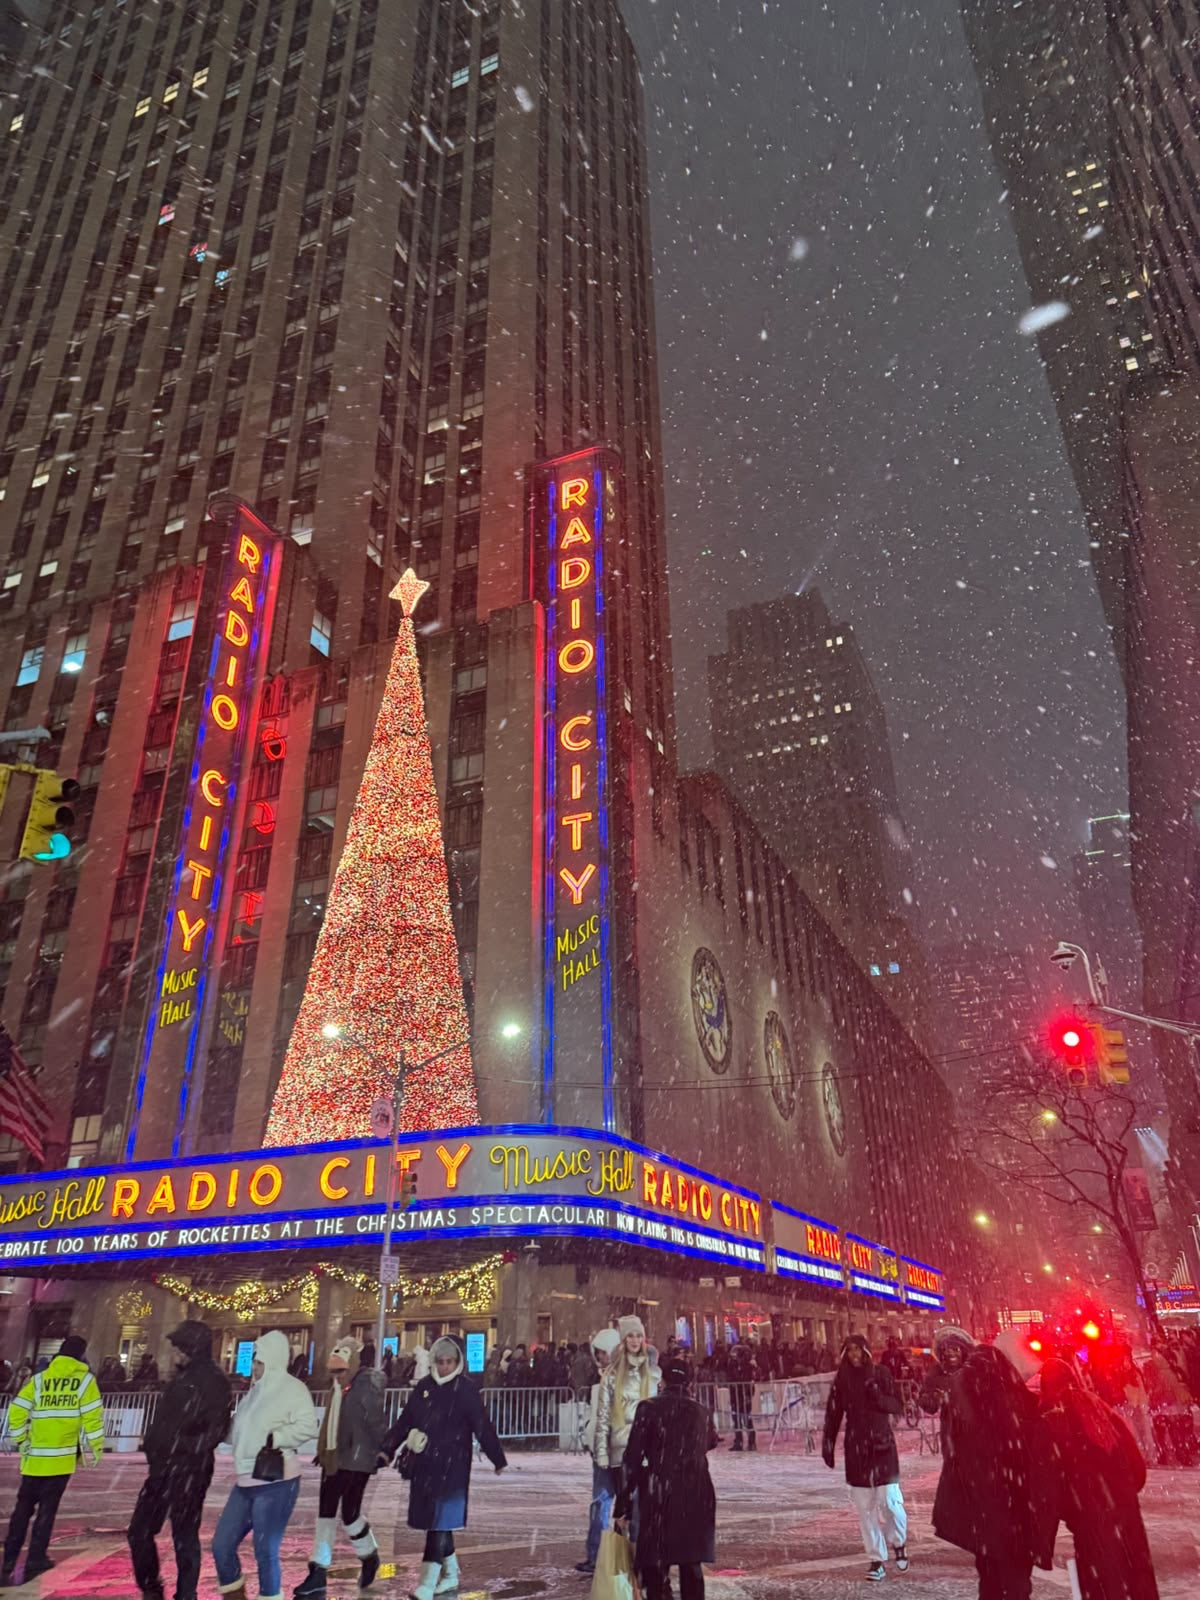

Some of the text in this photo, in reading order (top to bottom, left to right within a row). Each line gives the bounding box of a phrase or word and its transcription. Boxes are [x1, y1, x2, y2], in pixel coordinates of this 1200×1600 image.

[558, 478, 594, 674] RADIO
[211, 534, 260, 731] RADIO
[559, 715, 597, 905] CITY
[177, 769, 227, 952] CITY
[556, 914, 600, 962] MUSIC
[160, 967, 198, 998] MUSIC
[561, 948, 601, 991] HALL
[159, 999, 191, 1028] HALL
[0, 1143, 634, 1229] usic Hall RADIO CITY Music Hall
[643, 1162, 761, 1235] RADIO CITY
[56, 1237, 84, 1253] 100
[94, 1233, 138, 1251] YEARS
[147, 1230, 169, 1247] OF
[177, 1223, 271, 1244] ROCKETTES
[280, 1219, 304, 1238] AT
[314, 1217, 345, 1236] THE
[356, 1208, 457, 1233] CHRISTMAS
[616, 1211, 635, 1232] NOW
[637, 1216, 668, 1240] PLAYING
[670, 1226, 685, 1245] THIS
[686, 1230, 694, 1247] IS
[805, 1224, 841, 1261] RADIO
[852, 1242, 872, 1272] CITY
[39, 1394, 78, 1407] TRAFFIC
[43, 1377, 80, 1392] NYPD
